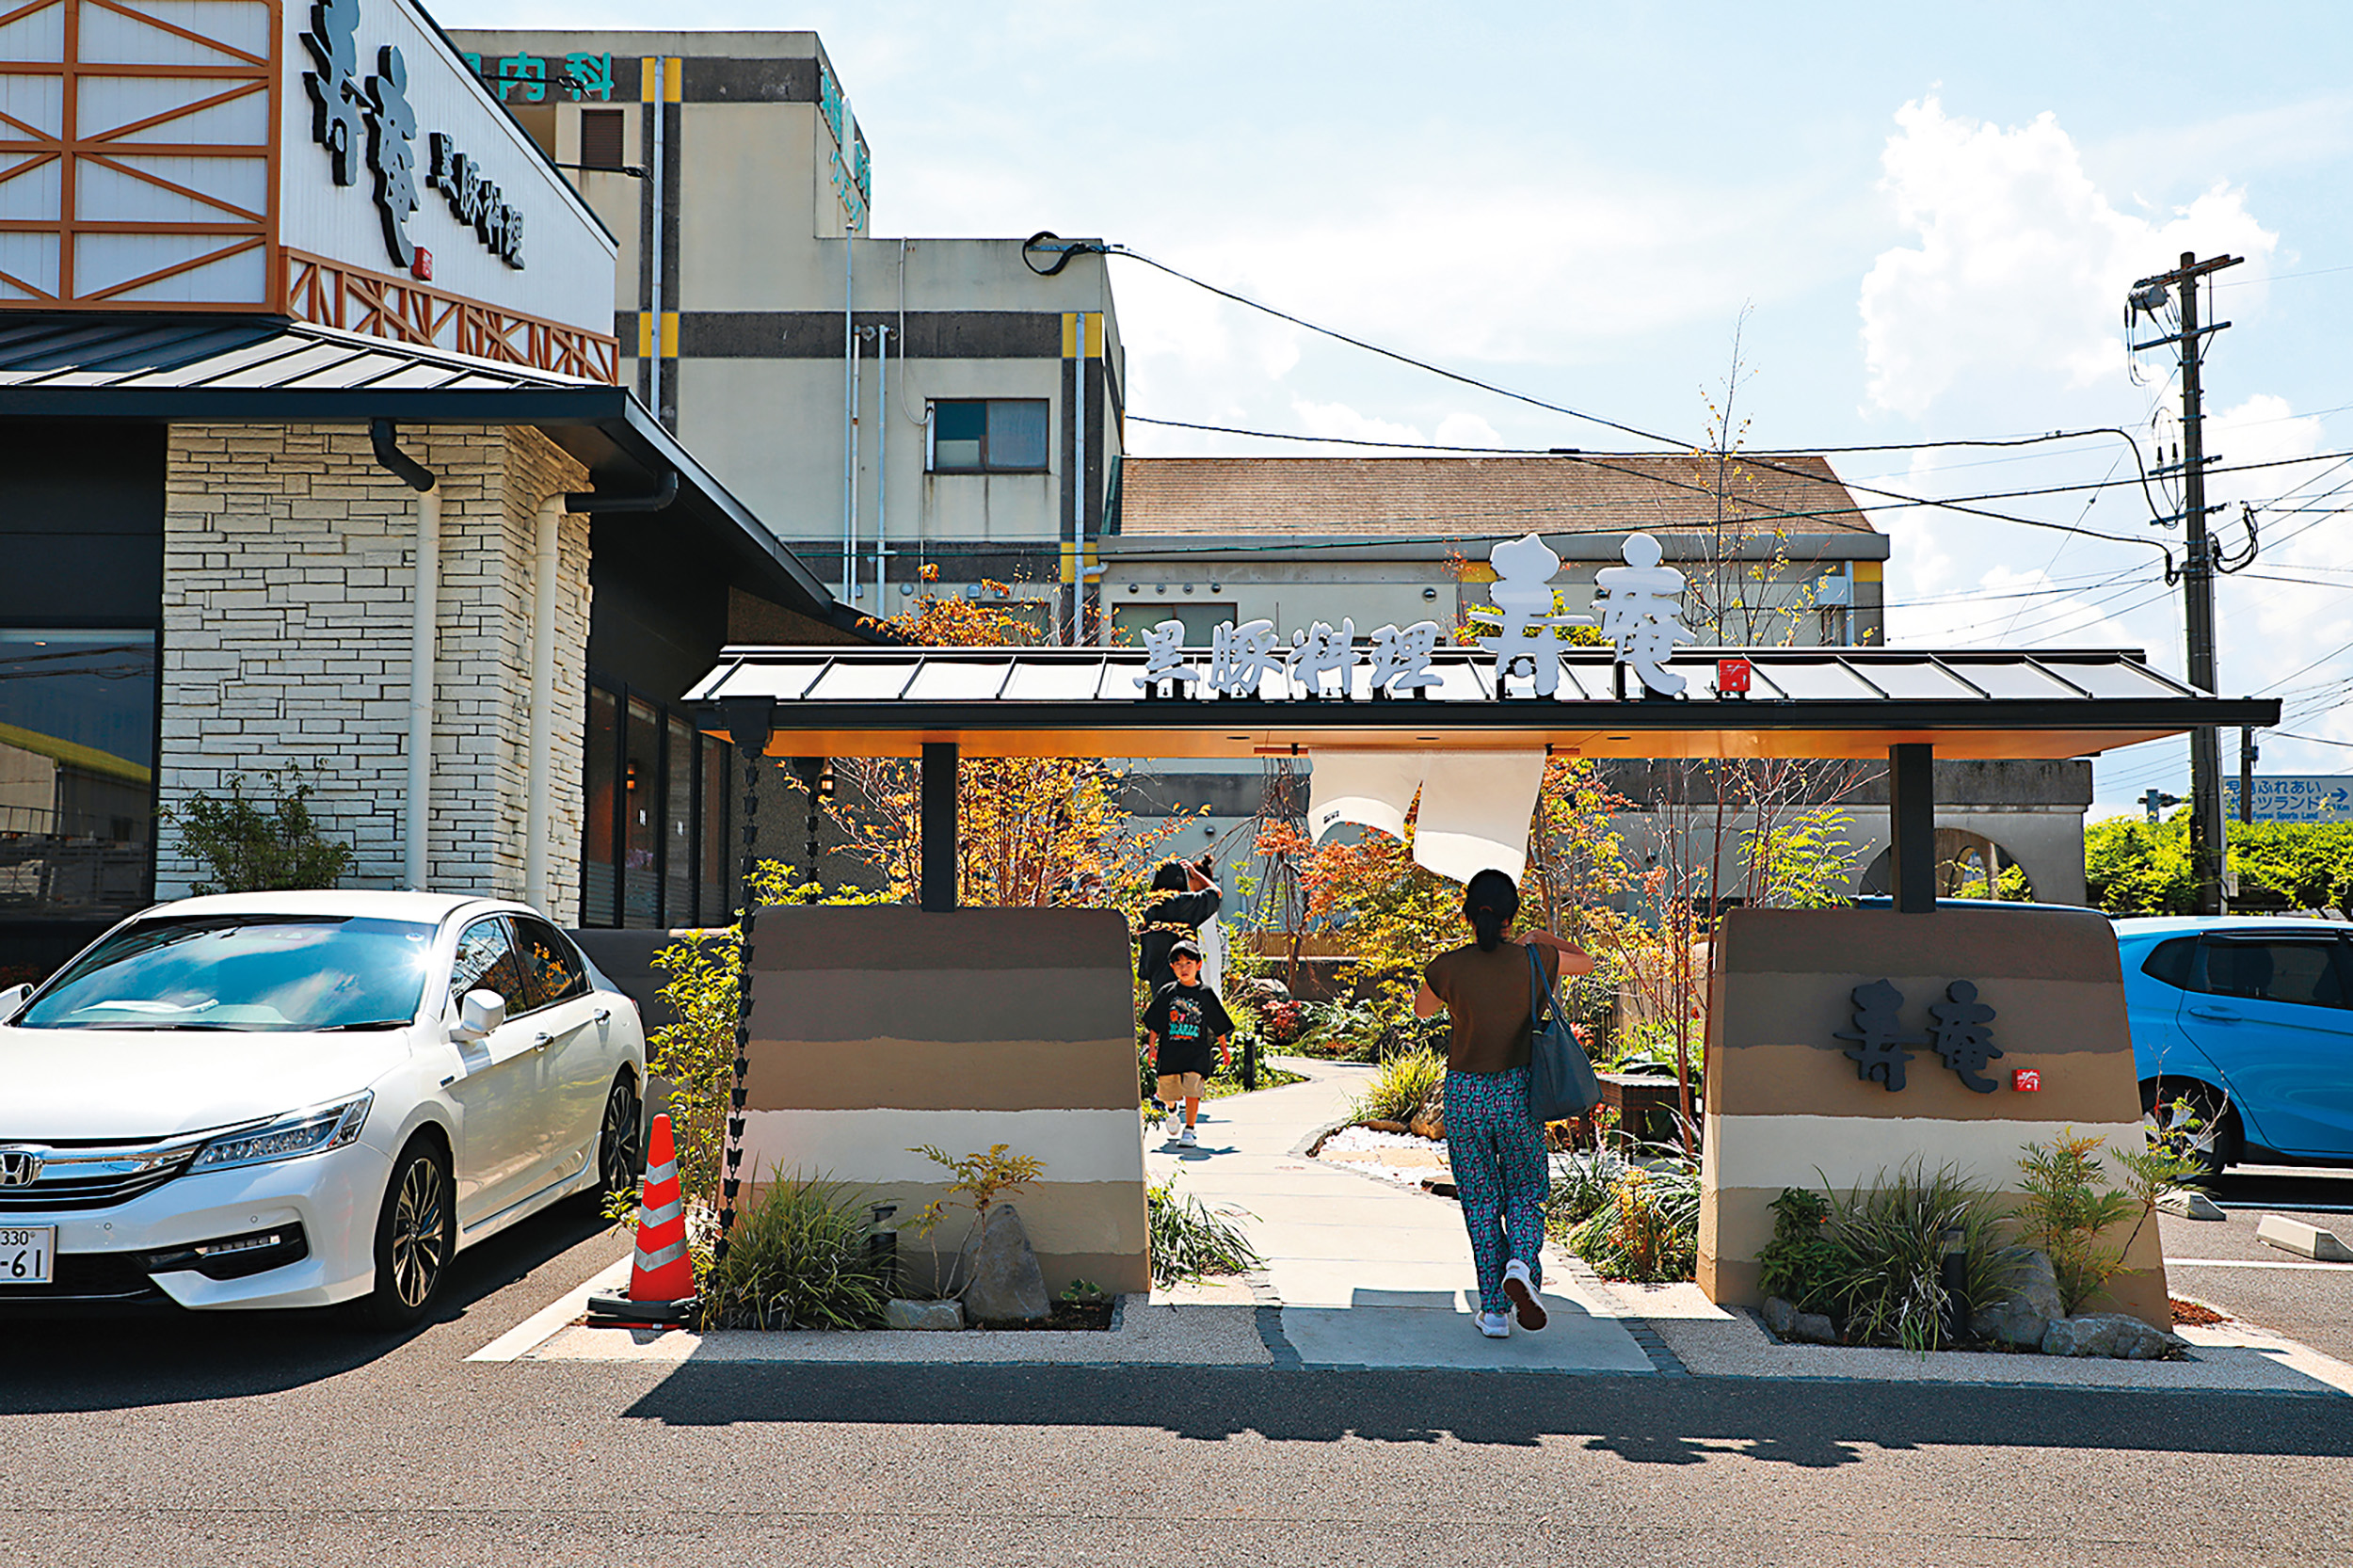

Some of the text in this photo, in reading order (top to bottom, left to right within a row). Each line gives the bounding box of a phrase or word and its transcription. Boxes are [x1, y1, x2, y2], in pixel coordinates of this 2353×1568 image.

[462, 51, 615, 102] 内科
[1132, 616, 1444, 694] 黒豚料理
[2276, 811, 2298, 820] Sports
[2301, 811, 2318, 820] Land
[0, 1230, 29, 1246] 330
